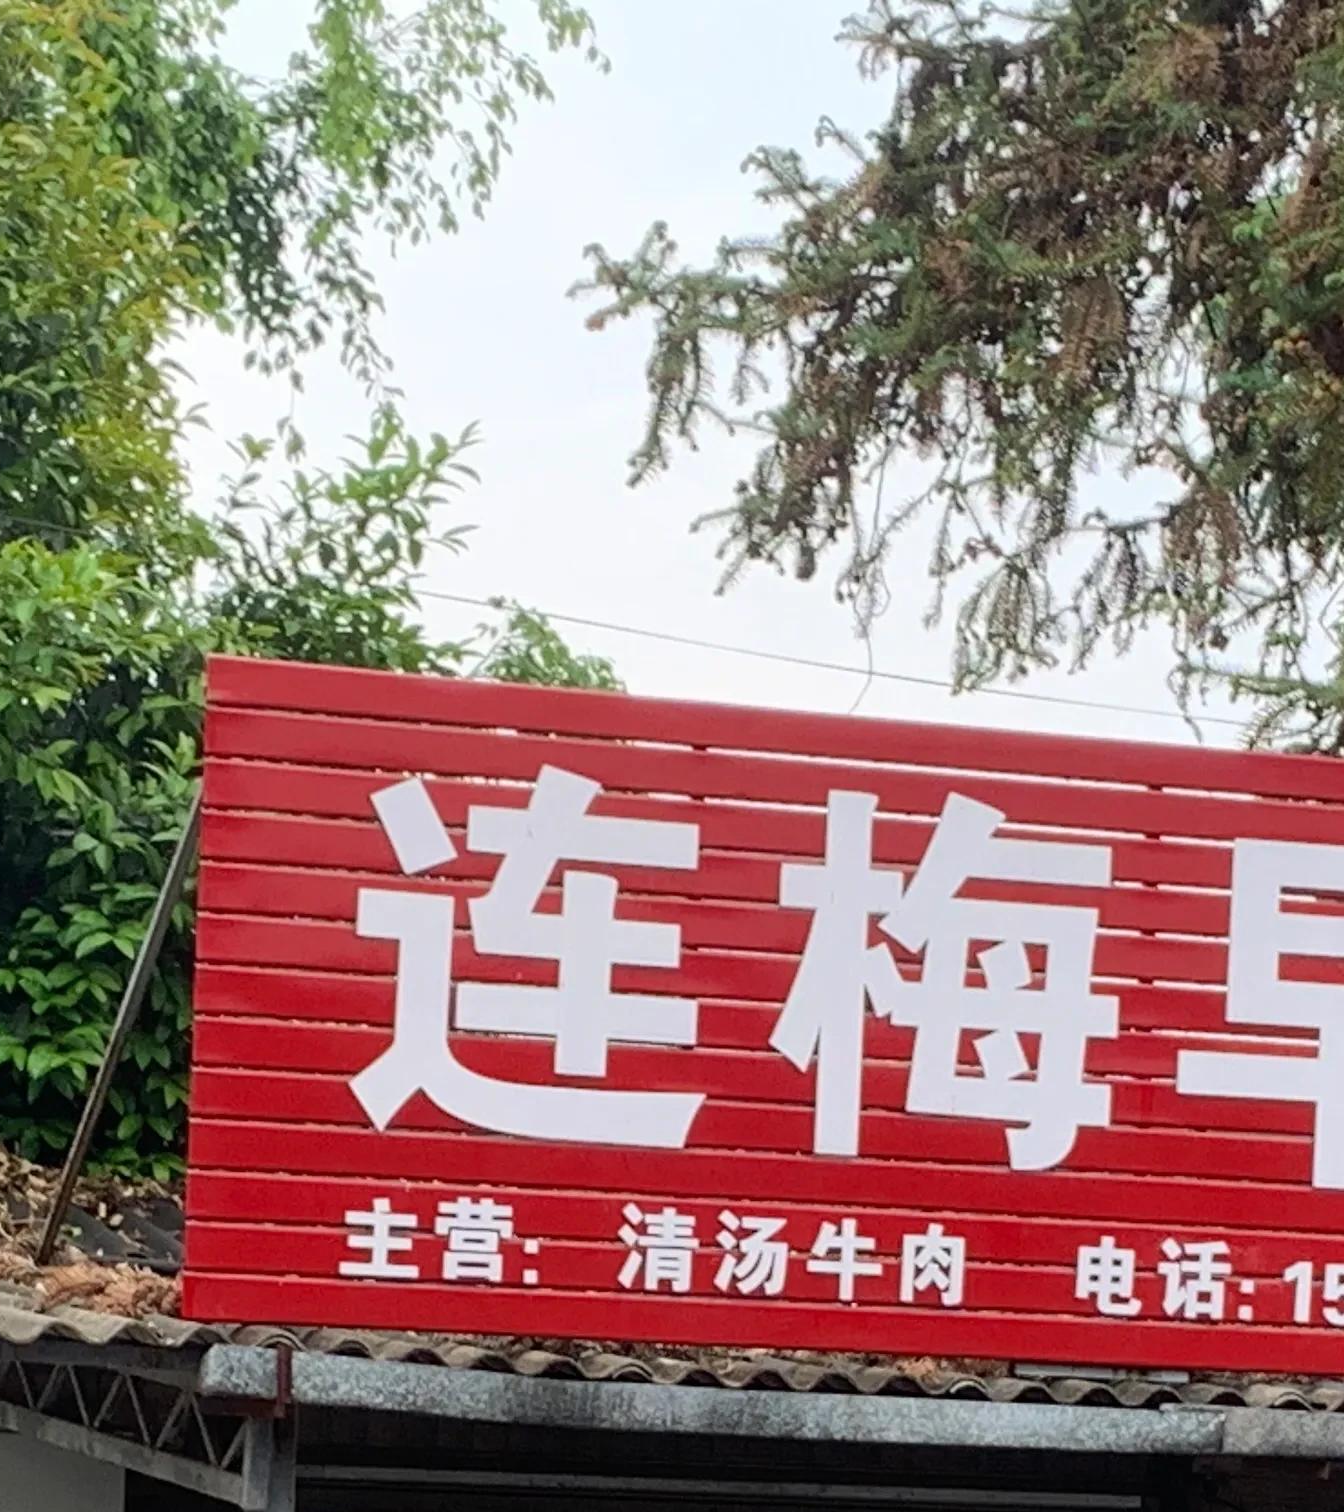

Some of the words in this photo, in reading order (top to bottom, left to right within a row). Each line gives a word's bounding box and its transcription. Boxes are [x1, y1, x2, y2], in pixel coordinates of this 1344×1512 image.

[339, 1197, 539, 1286] 主营：
[616, 1202, 968, 1307] 清汤牛肉
